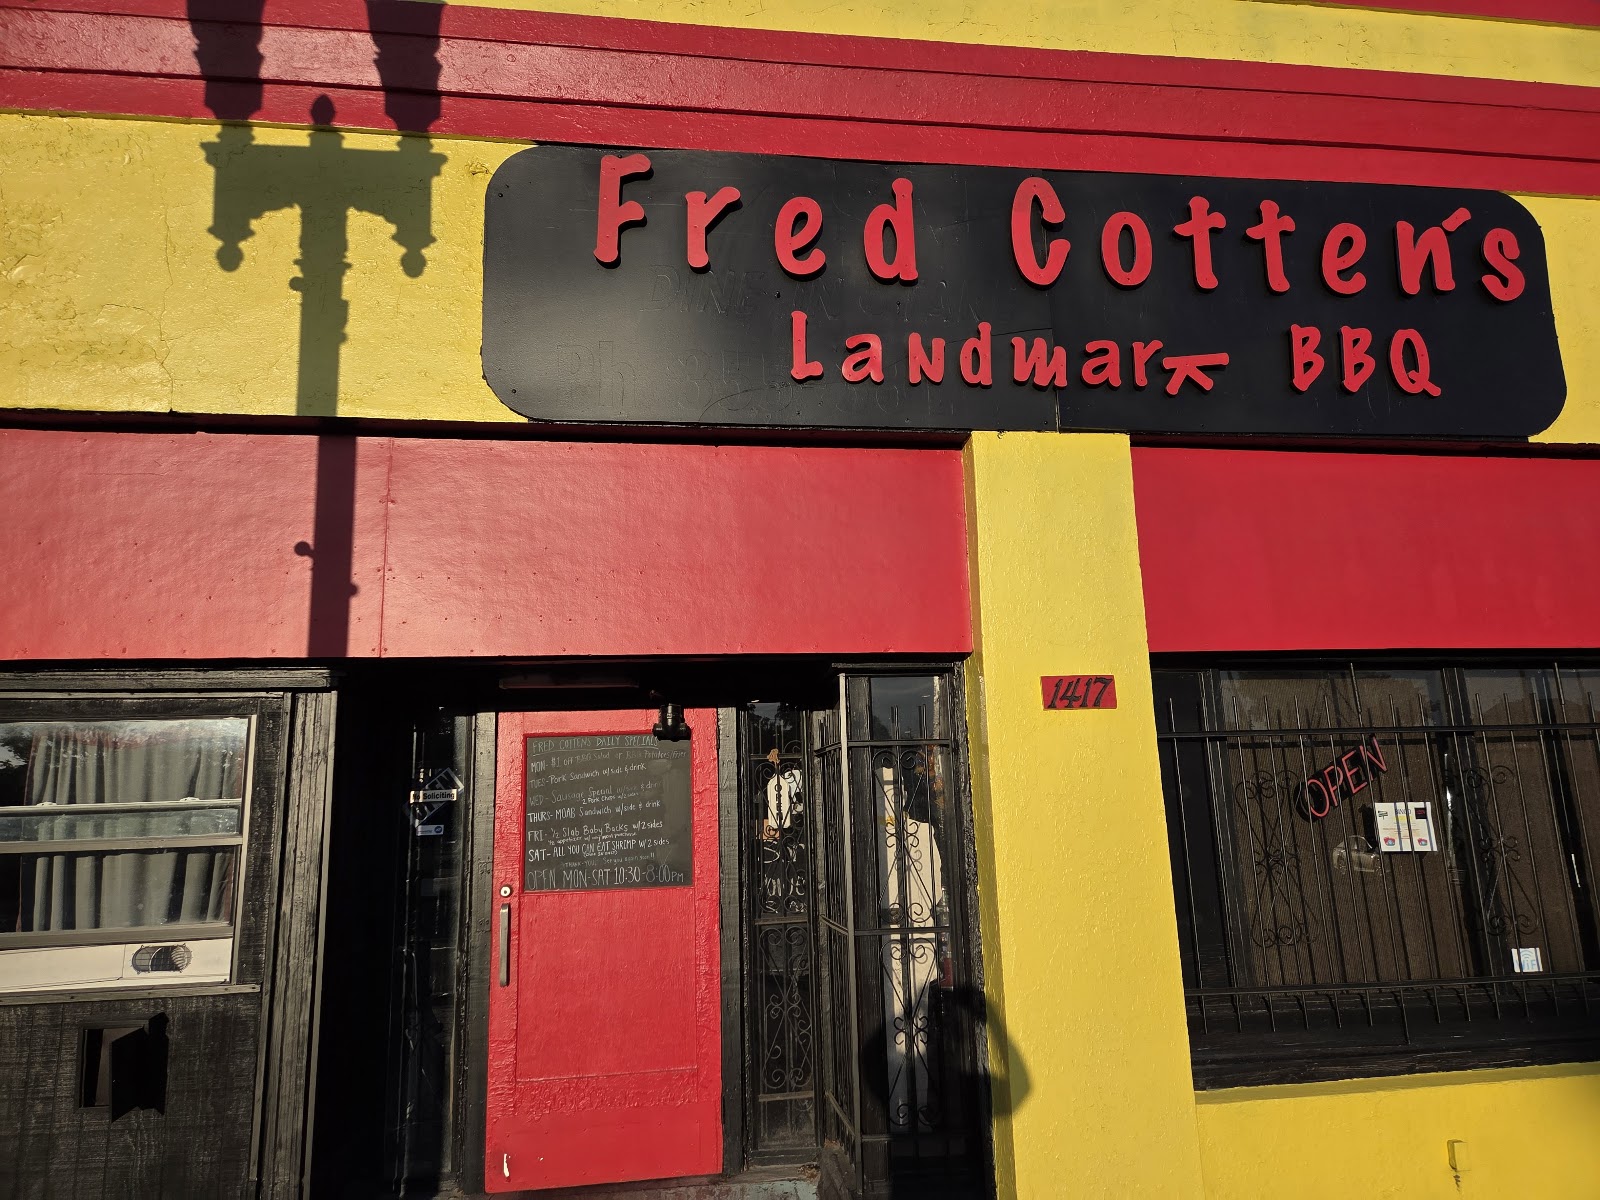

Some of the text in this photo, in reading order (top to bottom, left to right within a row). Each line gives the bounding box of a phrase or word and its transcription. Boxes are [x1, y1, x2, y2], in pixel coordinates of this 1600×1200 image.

[594, 154, 1525, 301] Fred Cotten's
[1289, 324, 1441, 397] BBQ
[1048, 677, 1113, 708] 1417
[532, 740, 555, 754] FRED
[596, 735, 620, 746] DAILY
[624, 735, 659, 747] SPECIALS
[531, 760, 549, 773] MON-
[551, 757, 560, 768] $1
[569, 769, 600, 781] Sandwich
[629, 763, 647, 771] drink
[1305, 736, 1387, 817] OPEN
[423, 792, 455, 800] Soliciting
[551, 790, 584, 804] Sausage
[588, 785, 612, 798] Special
[555, 808, 576, 820] MOAB
[579, 805, 612, 817] Sandwich
[645, 800, 661, 808] drink
[562, 827, 580, 837] Slab
[583, 824, 603, 836] Baby
[604, 823, 629, 833] Backs
[553, 846, 566, 858] ALL
[567, 844, 580, 855] YOU
[581, 842, 595, 854] CAN
[596, 840, 611, 852] EAT
[611, 839, 637, 850] SHRIMP
[526, 867, 557, 890] OPEN
